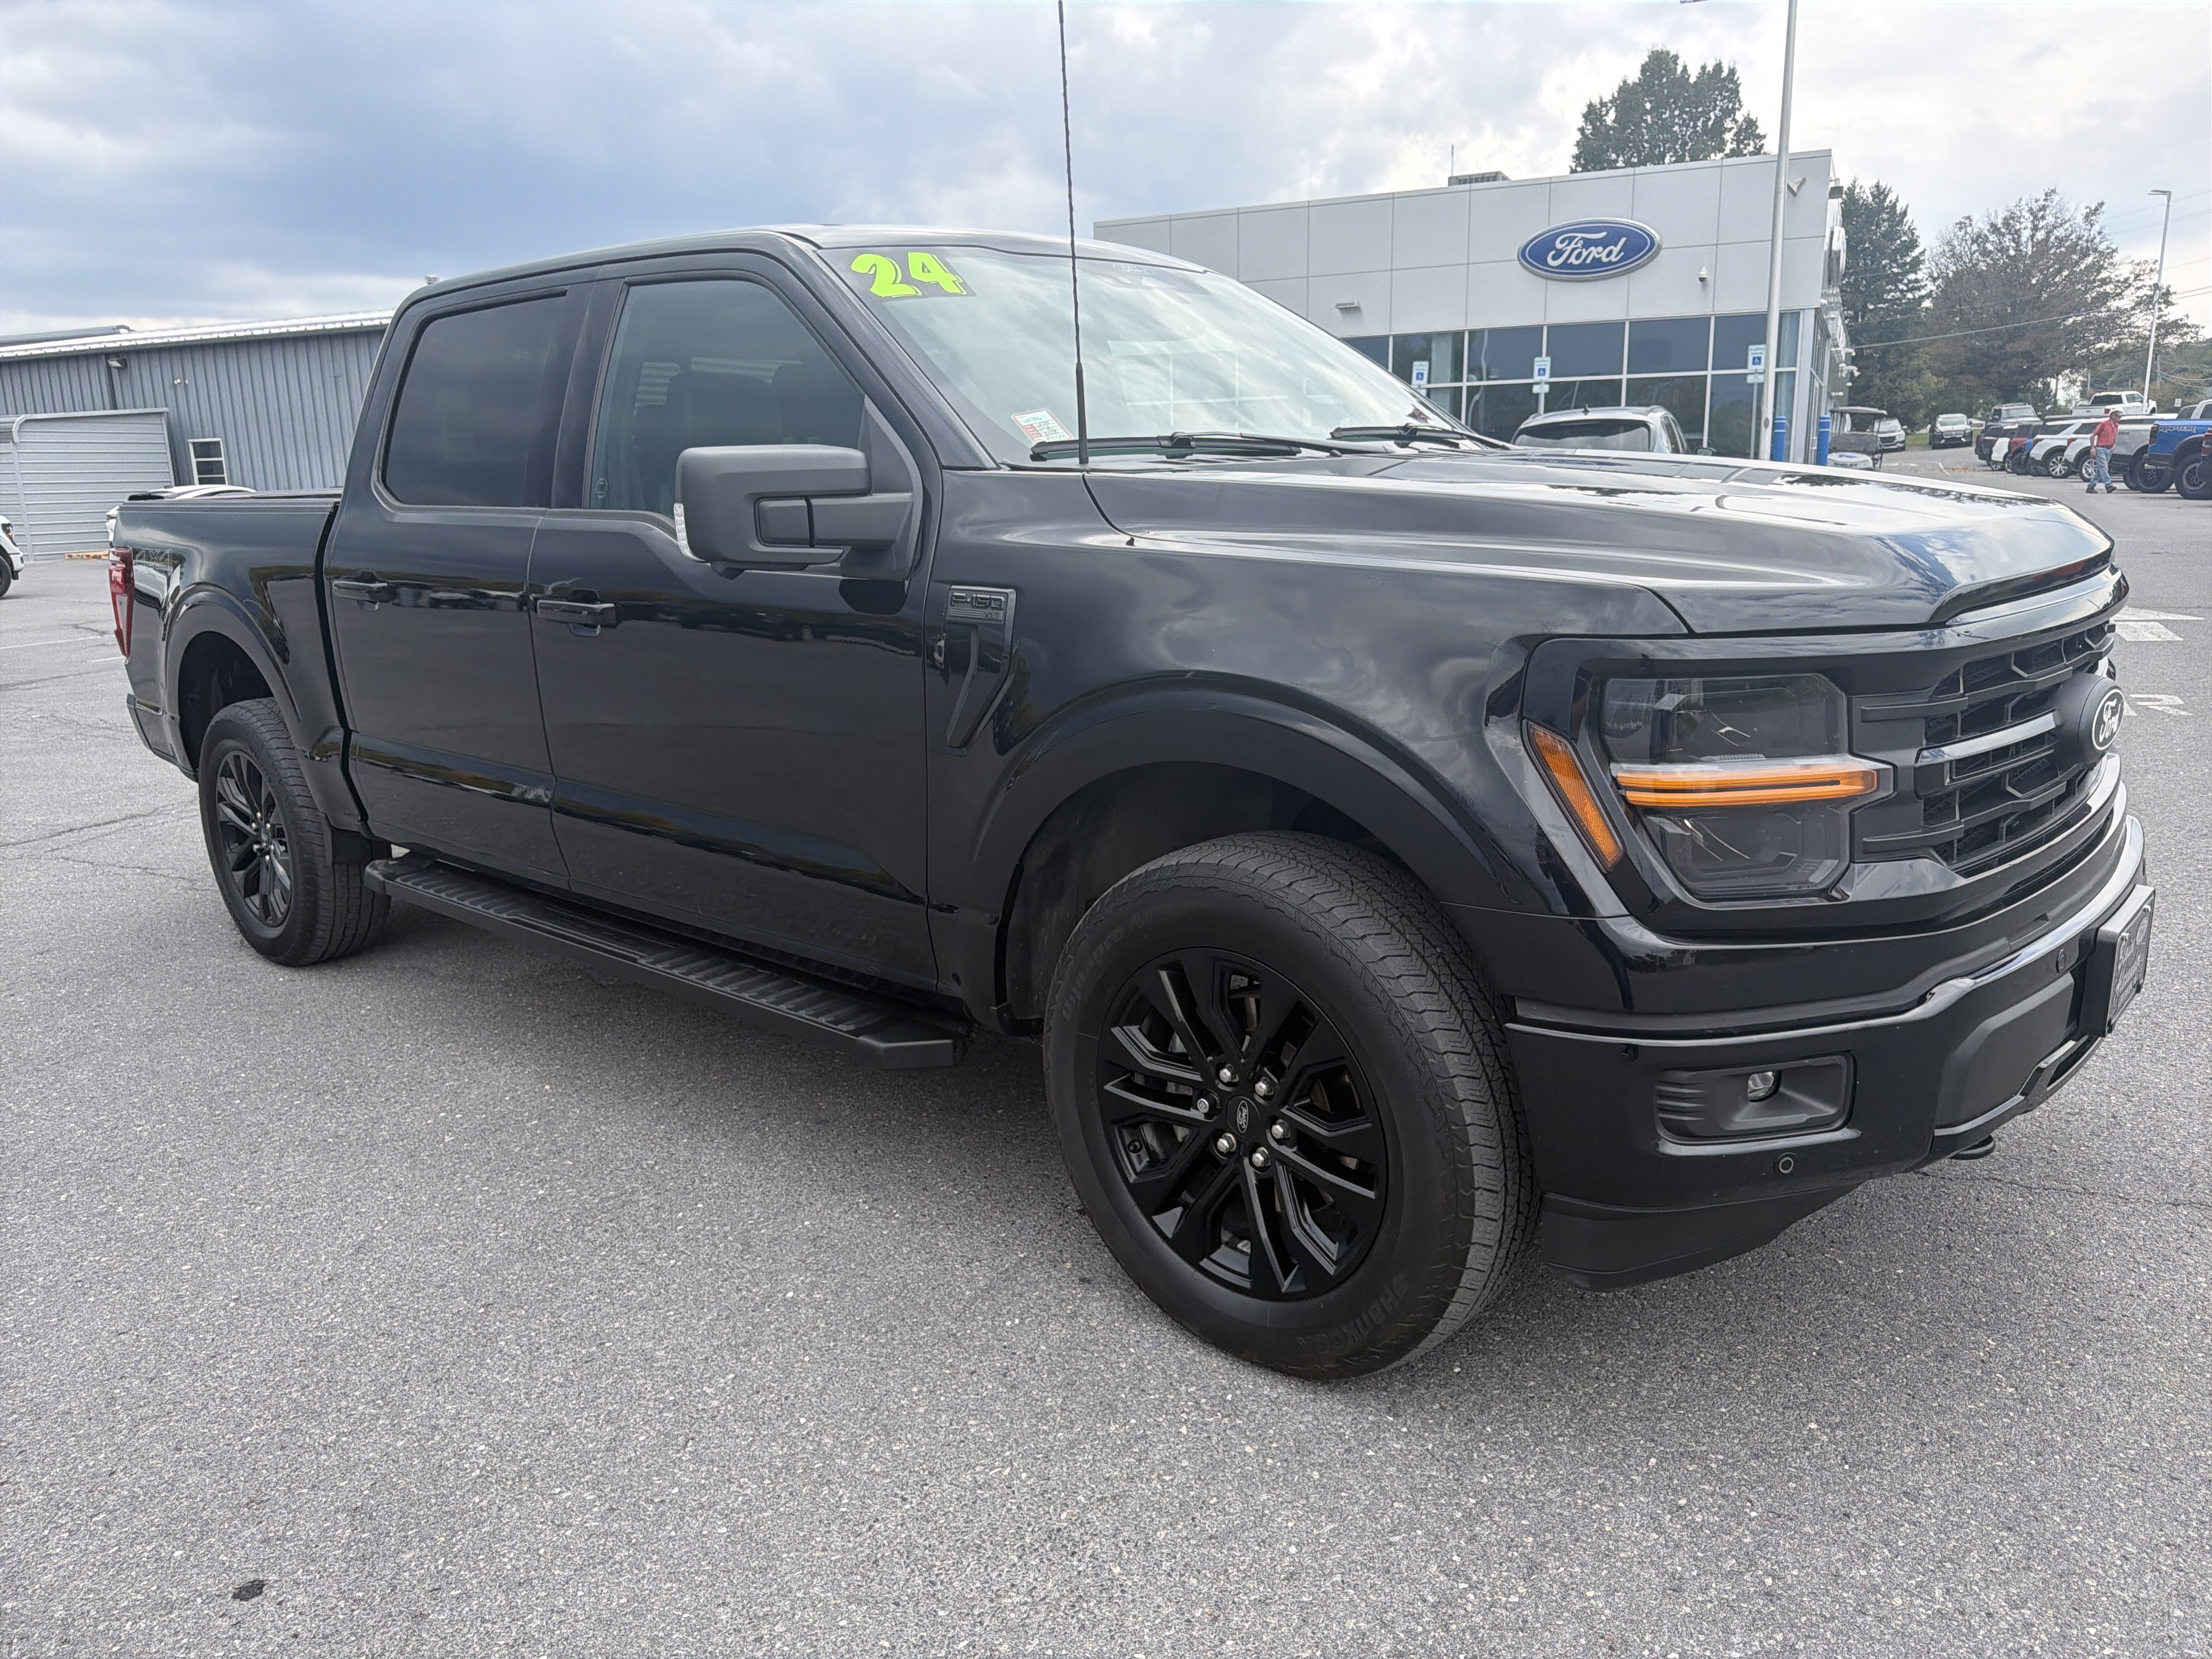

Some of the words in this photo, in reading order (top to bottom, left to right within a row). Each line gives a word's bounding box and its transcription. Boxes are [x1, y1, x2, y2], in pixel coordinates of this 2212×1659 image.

[1547, 231, 1627, 267] Ford
[850, 252, 967, 298] 24
[950, 592, 1005, 610] F-150
[984, 610, 1000, 619] XLT
[2099, 697, 2121, 743] Ford
[1238, 1105, 1247, 1128] Ford
